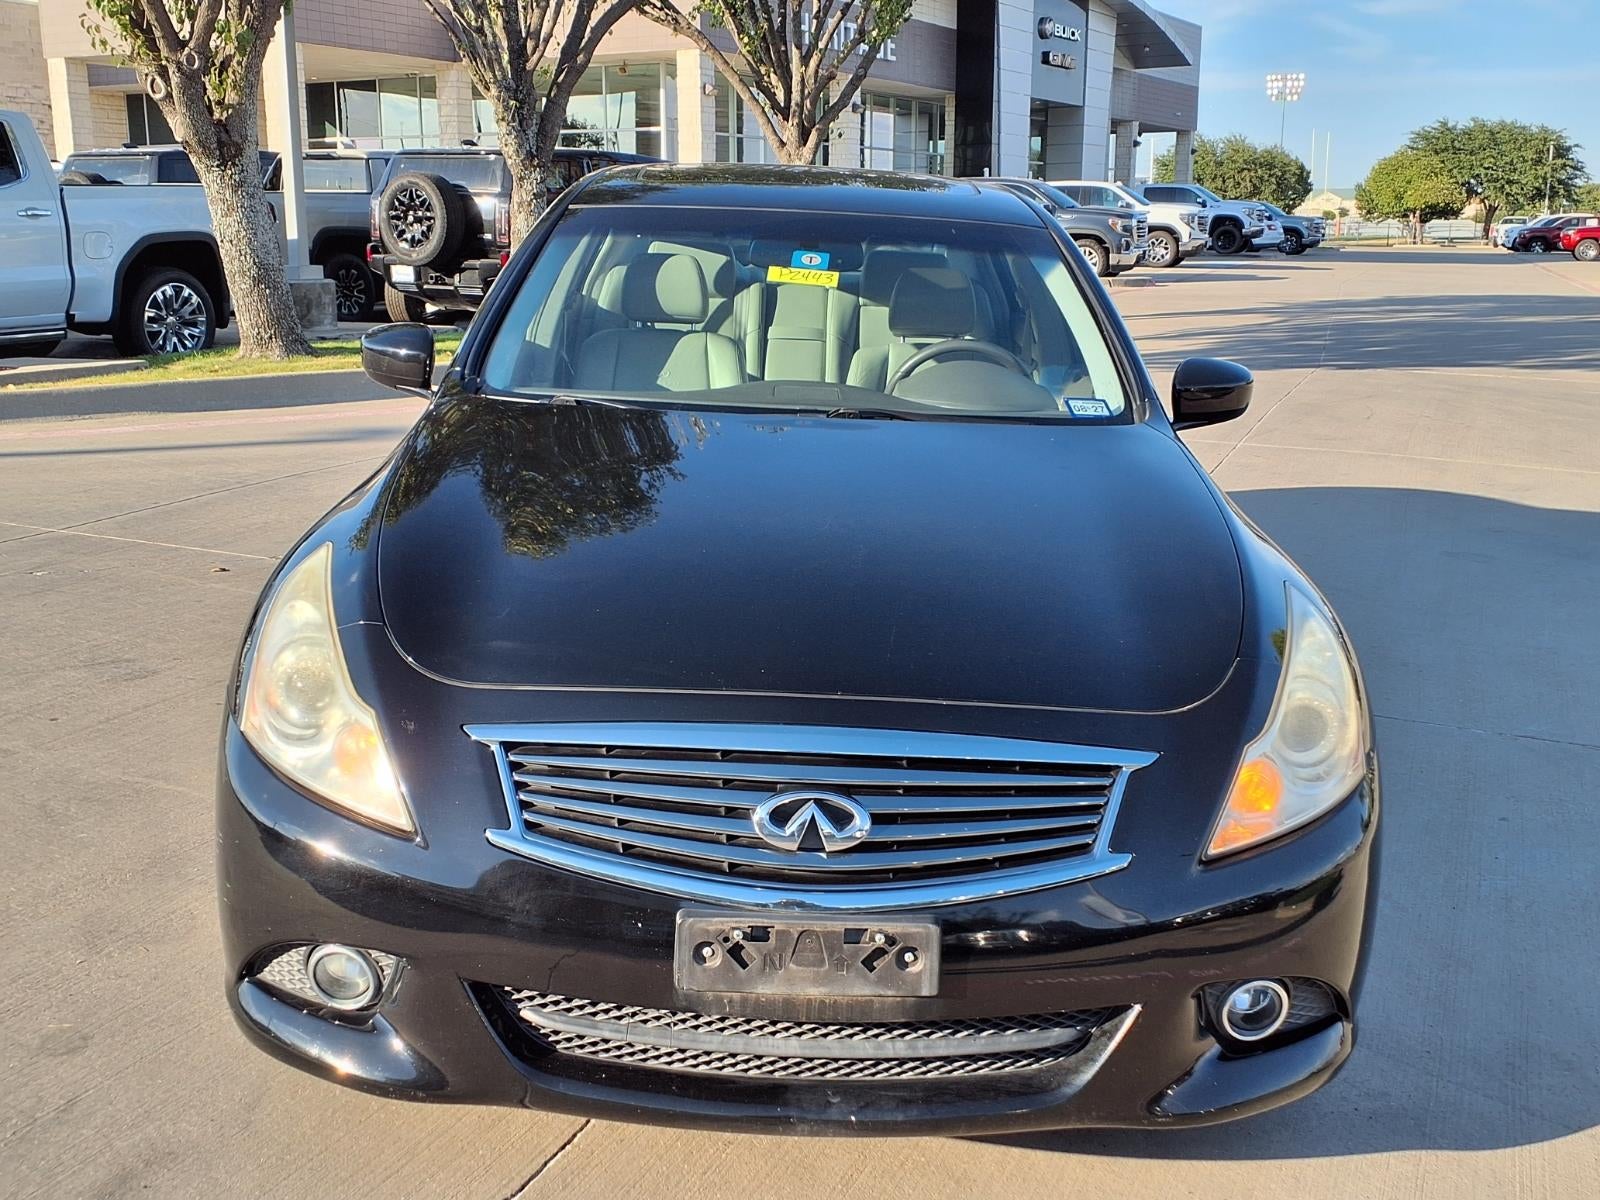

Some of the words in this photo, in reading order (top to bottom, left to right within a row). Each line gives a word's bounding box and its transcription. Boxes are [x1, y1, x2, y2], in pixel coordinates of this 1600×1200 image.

[1054, 23, 1081, 41] BUICK
[805, 256, 816, 264] T
[779, 268, 834, 284] P2443
